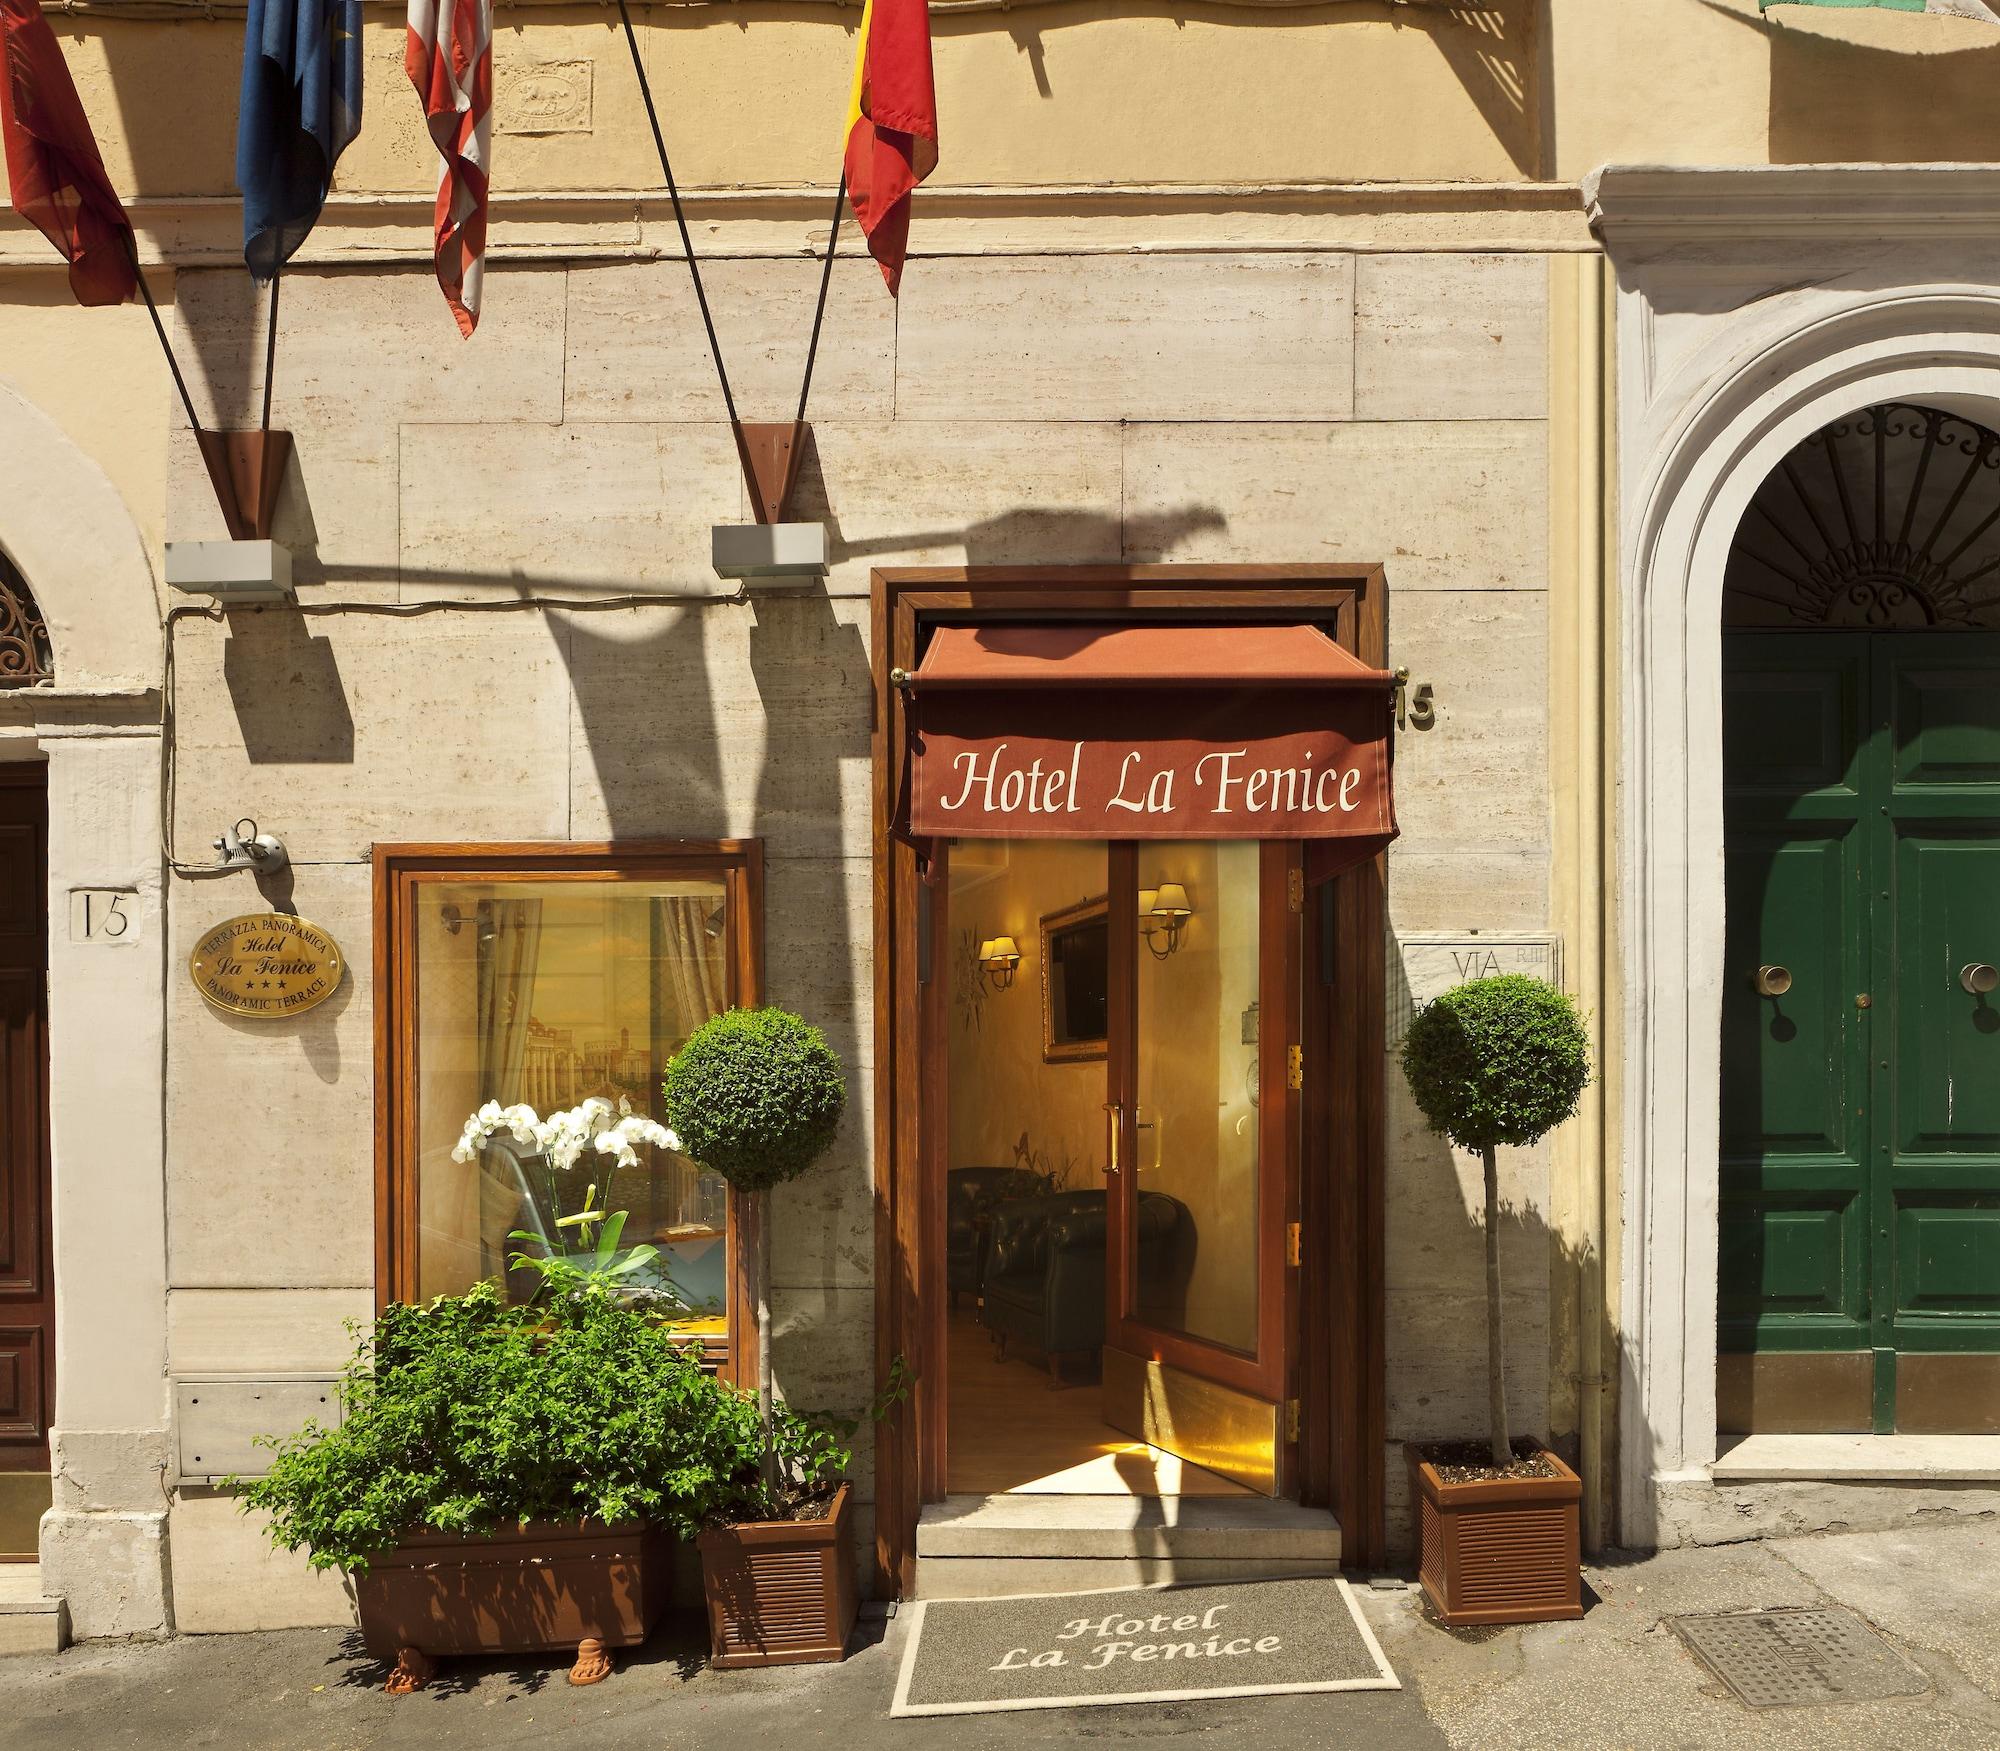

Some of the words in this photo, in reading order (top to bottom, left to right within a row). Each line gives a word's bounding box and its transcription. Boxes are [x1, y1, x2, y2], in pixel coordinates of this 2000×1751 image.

[1395, 684, 1433, 720] 15
[940, 741, 1084, 813] Hotel
[1104, 751, 1175, 813] La
[1194, 748, 1362, 813] Fenice
[84, 894, 128, 937] 15
[203, 922, 257, 955] TERRAZZA
[262, 920, 327, 954] PANORAMICA
[241, 936, 287, 953] Hotel
[216, 956, 243, 977] La
[254, 956, 317, 975] Fenice
[1450, 951, 1501, 979] VIA
[206, 978, 271, 1010] PANORAMIC
[275, 977, 327, 1009] TERRACE
[1055, 1604, 1229, 1640] Hotel
[988, 1648, 1069, 1671] La
[1082, 1634, 1283, 1670] Fenice
